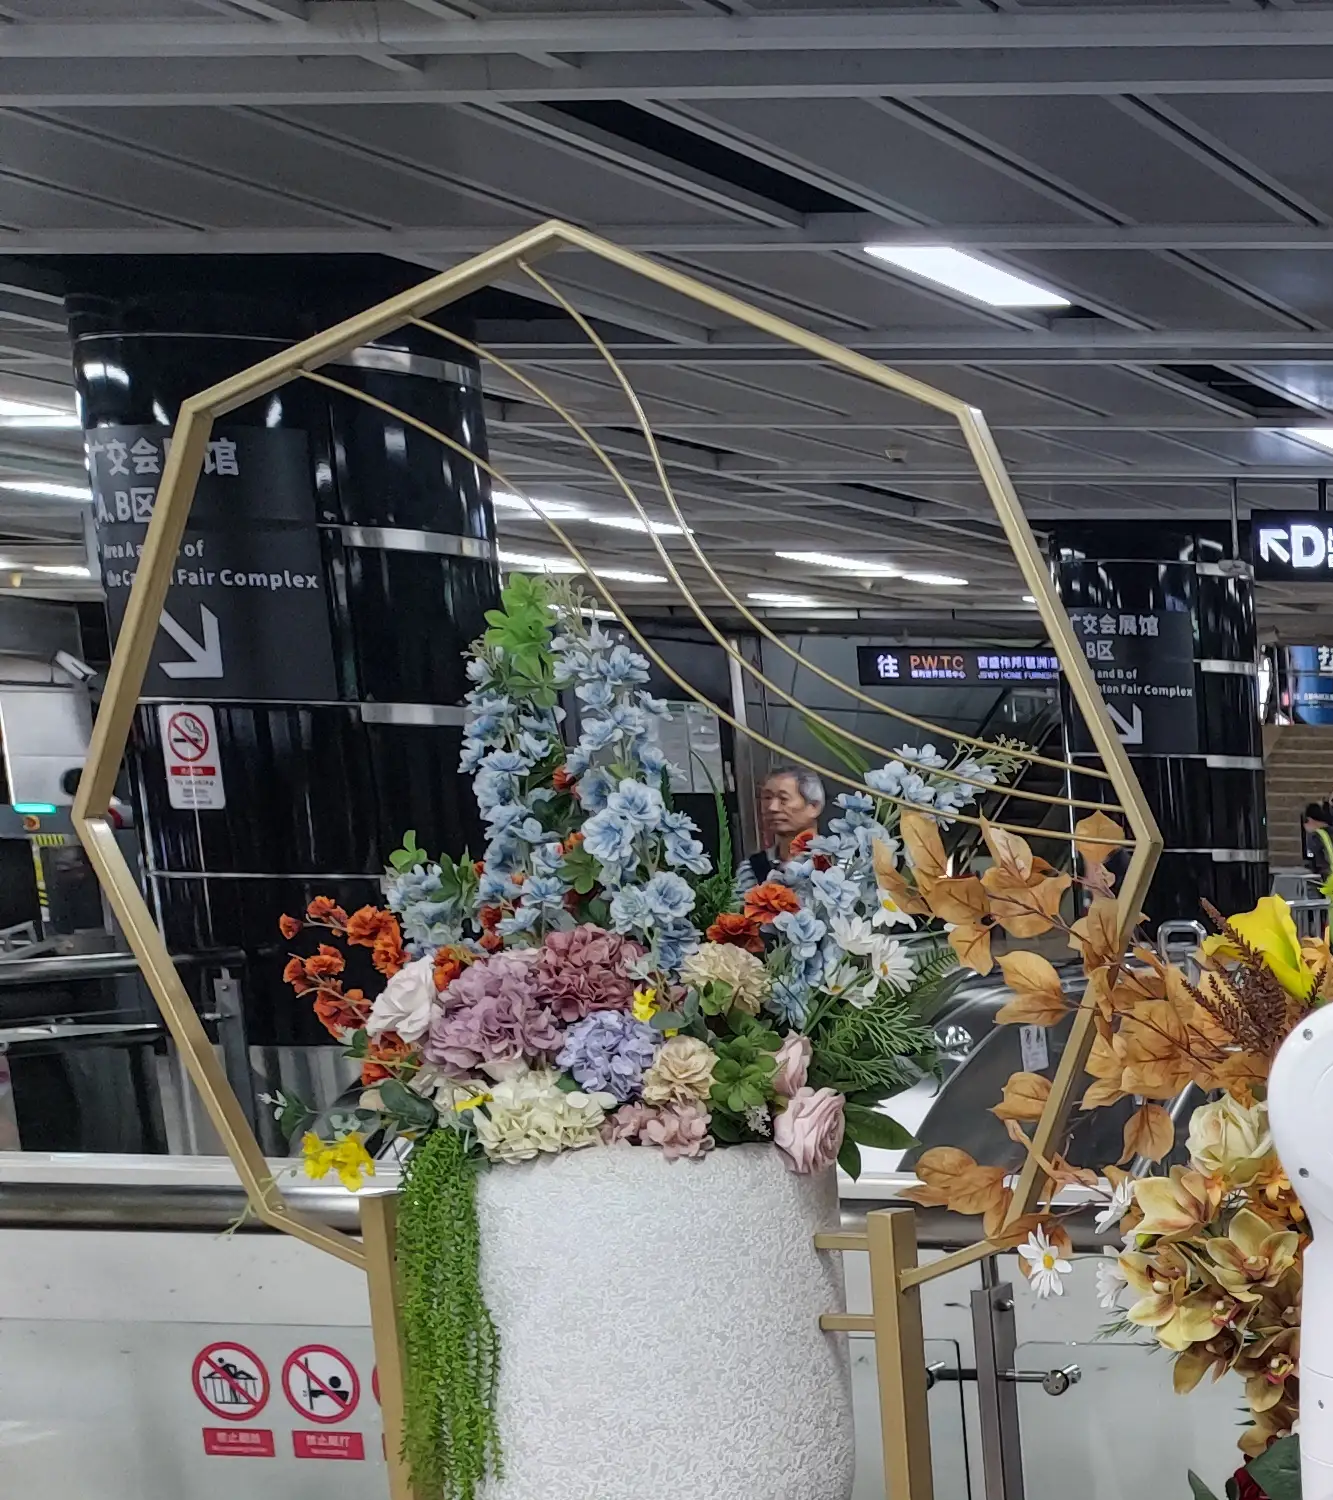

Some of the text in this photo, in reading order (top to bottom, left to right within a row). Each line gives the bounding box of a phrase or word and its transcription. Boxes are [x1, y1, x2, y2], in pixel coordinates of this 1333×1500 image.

[184, 540, 205, 558] of
[1290, 524, 1325, 568] D
[177, 568, 216, 586] Fair
[219, 570, 319, 591] Complex
[877, 654, 900, 678] 往
[910, 655, 965, 670] PWTC
[1121, 684, 1141, 695] Fair
[1143, 685, 1193, 698] Complex
